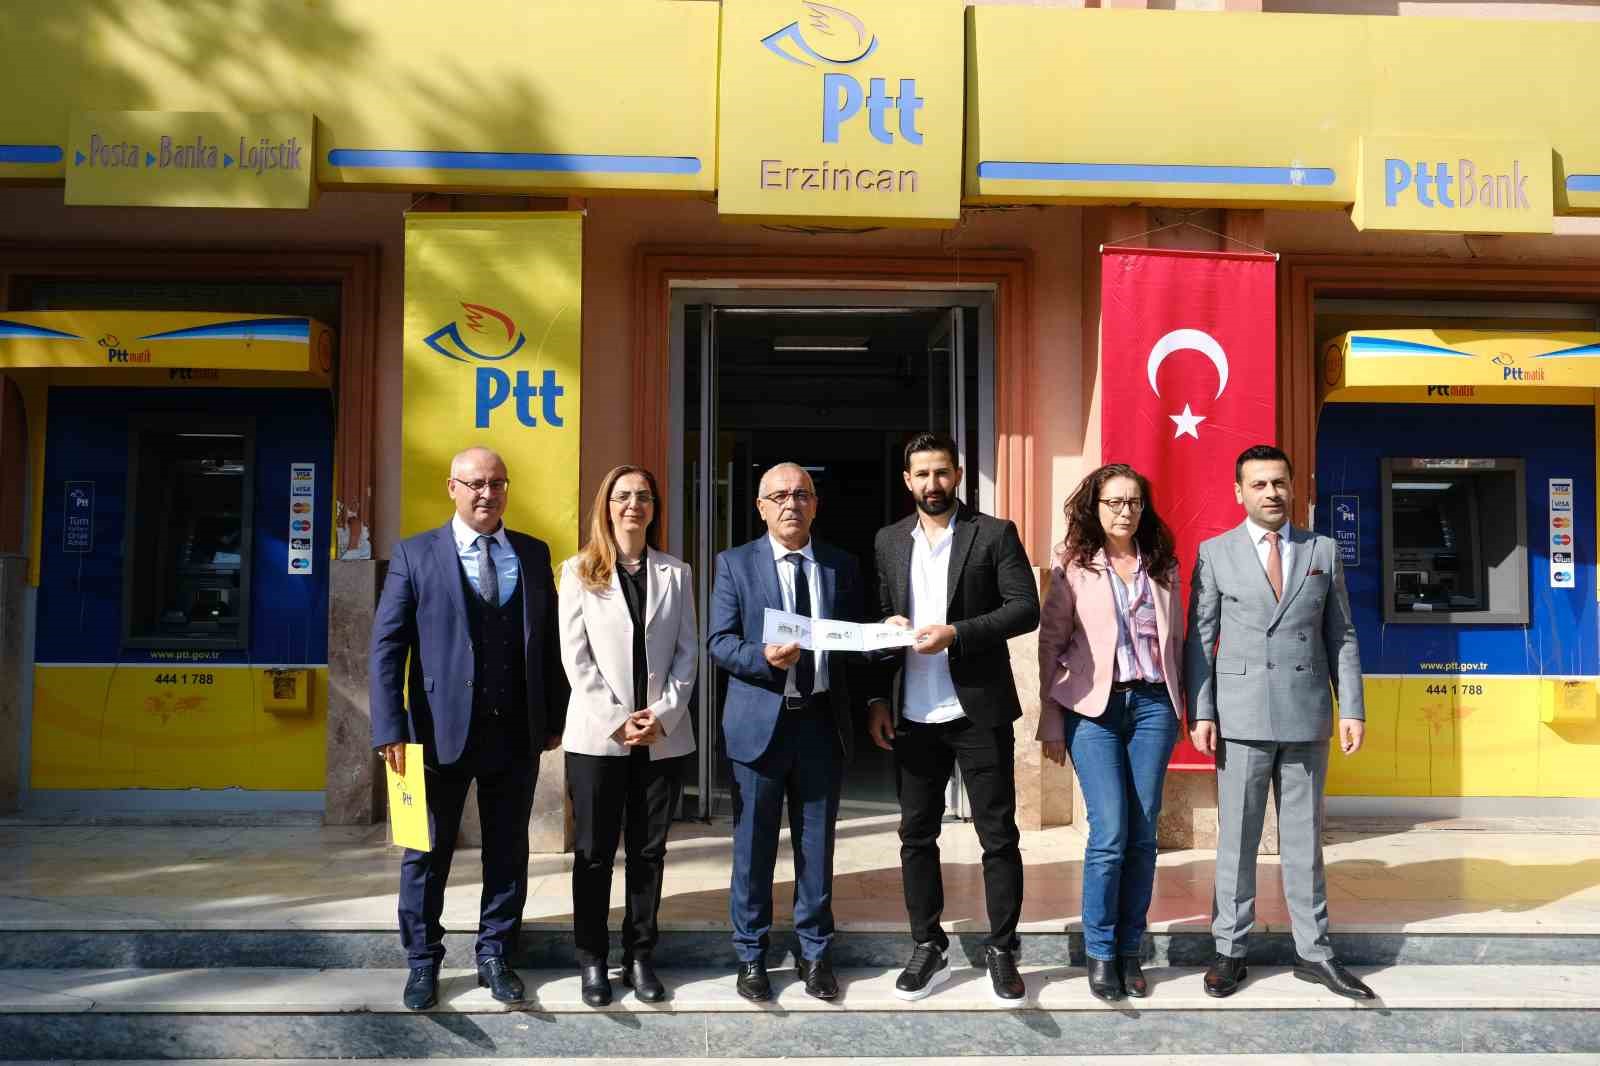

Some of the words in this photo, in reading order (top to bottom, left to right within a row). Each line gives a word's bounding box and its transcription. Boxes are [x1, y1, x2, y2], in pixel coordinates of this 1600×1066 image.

[822, 73, 924, 144] Ptt
[90, 134, 139, 167] Posta
[159, 136, 218, 168] Banka
[239, 136, 301, 175] Lojistik
[760, 160, 919, 192] Erzincan
[1385, 159, 1530, 208] PttBank
[475, 367, 564, 428] Ptt
[150, 651, 220, 661] www.ptt.gov.tr
[1420, 662, 1488, 672] www.ptt.gov.tr
[155, 674, 177, 685] 444
[181, 674, 188, 685] 1
[191, 674, 214, 685] 788
[1426, 685, 1447, 695] 444
[1451, 685, 1457, 695] 1
[1461, 685, 1483, 695] 788
